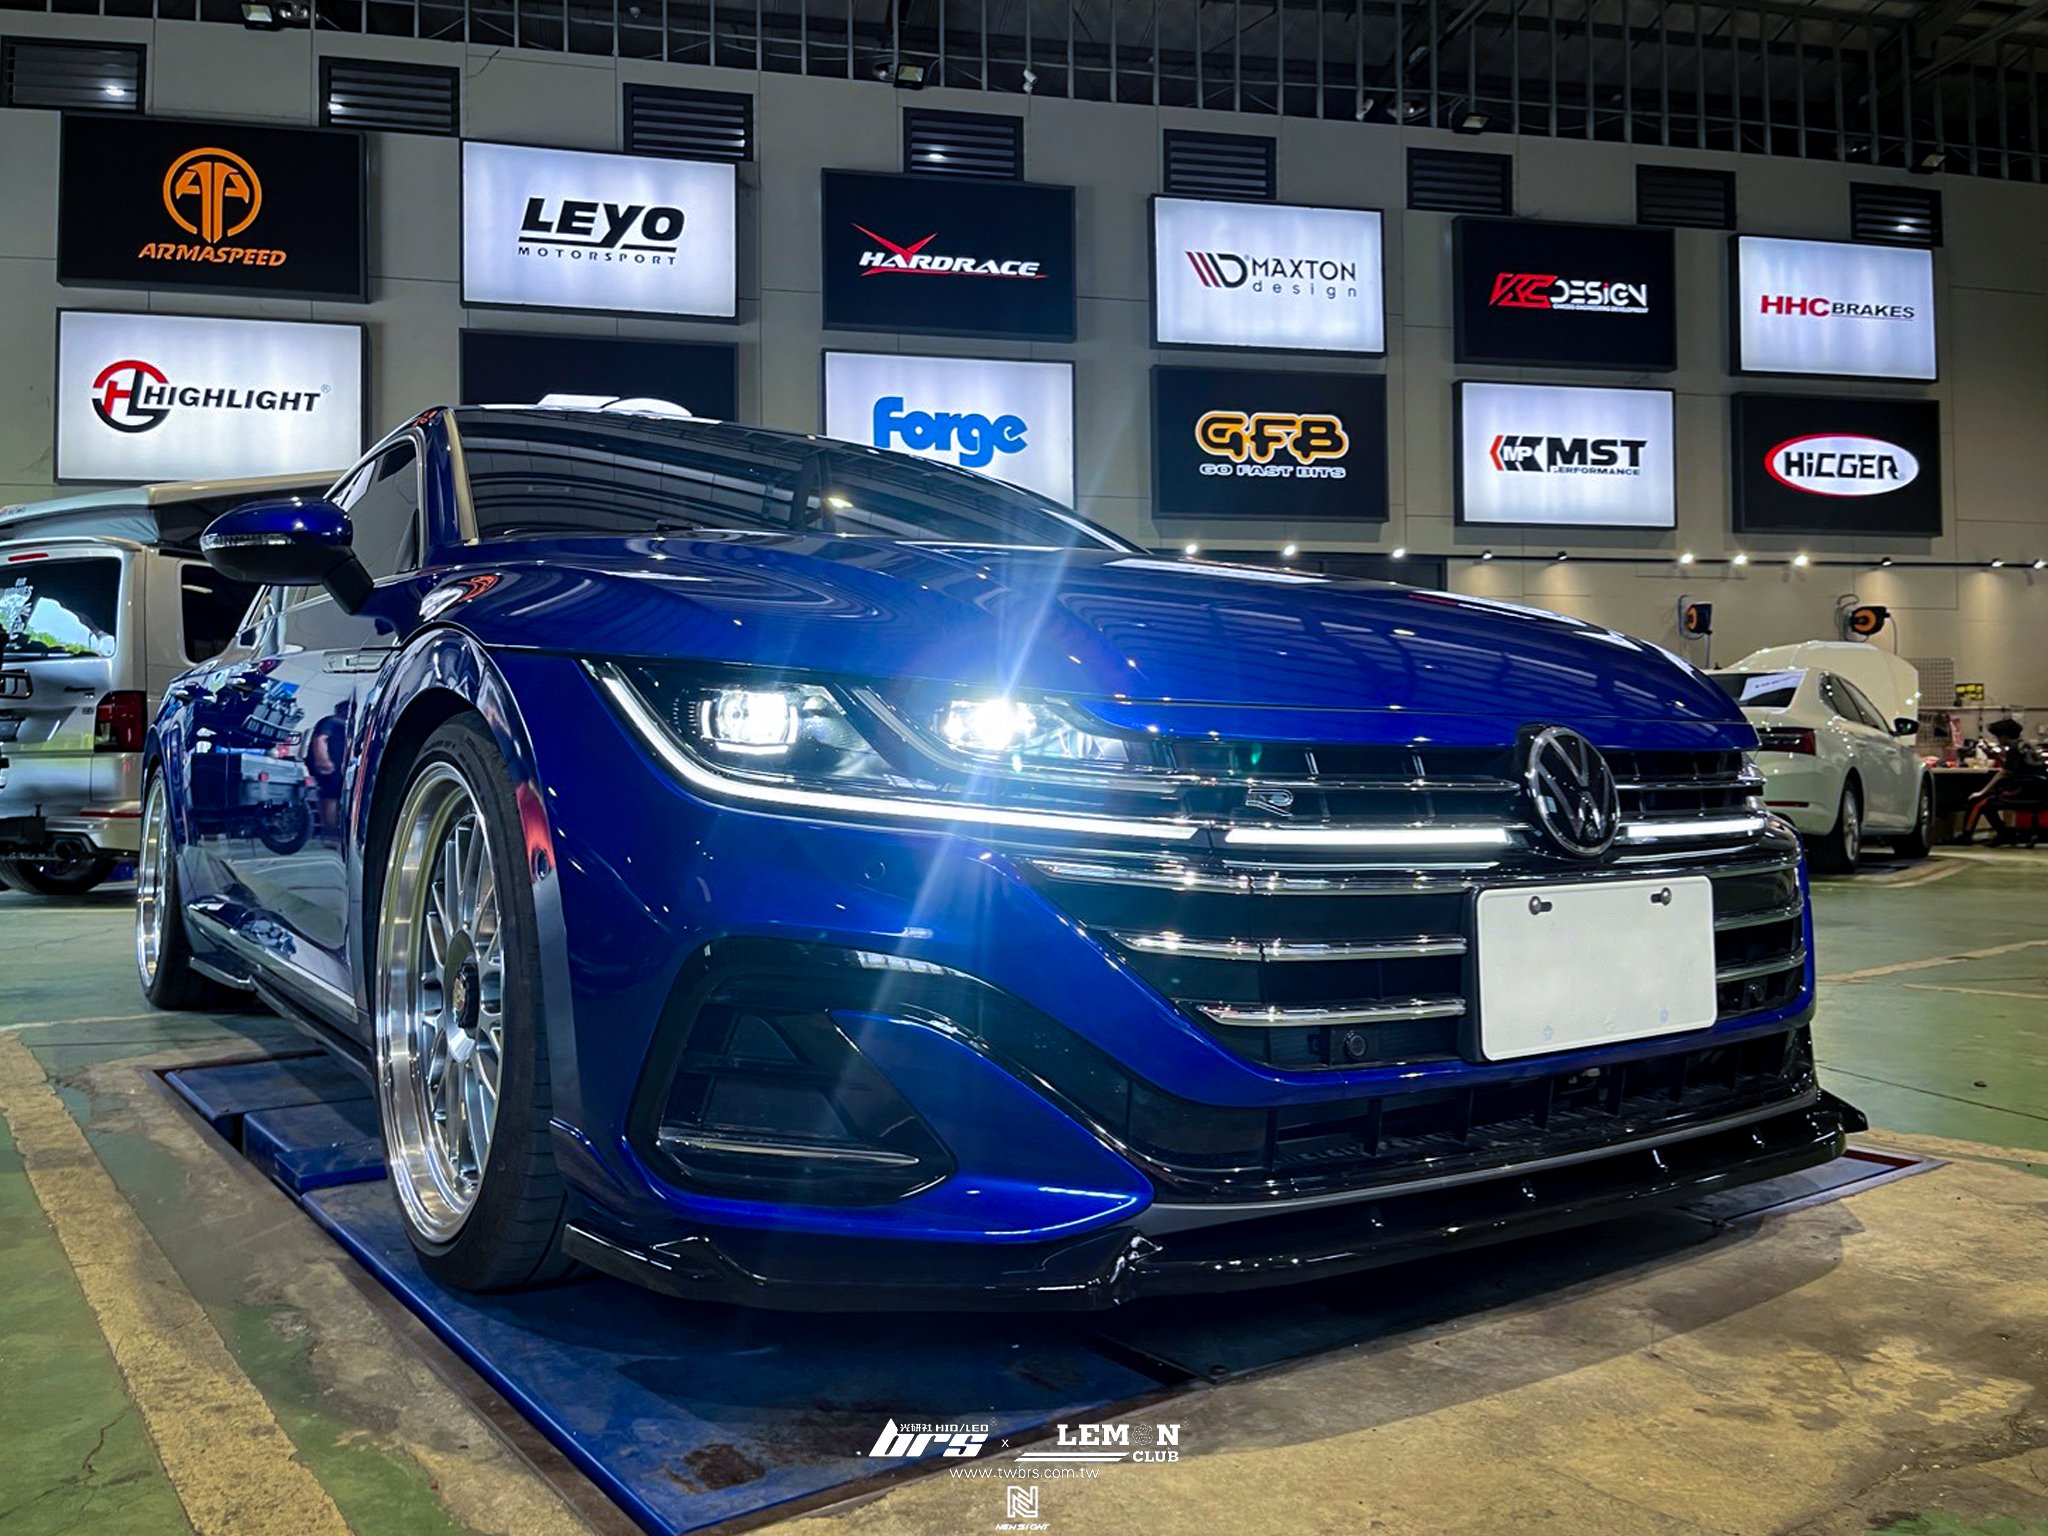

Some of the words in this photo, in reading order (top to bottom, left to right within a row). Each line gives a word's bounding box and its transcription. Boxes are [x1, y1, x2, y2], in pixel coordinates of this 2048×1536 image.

[521, 197, 685, 249] LEYO
[138, 242, 287, 267] ARMASPEED
[518, 246, 676, 266] MOTORSPORT
[858, 251, 1041, 277] HARDRACE
[1252, 257, 1356, 281] MAXTON
[1252, 280, 1357, 299] design
[1760, 295, 1830, 317] HHC
[1831, 302, 1915, 319] BRAKES
[143, 385, 321, 412] HIGHLIGHT
[1195, 410, 1349, 465] GFB
[1546, 437, 1648, 467] MST
[1199, 463, 1233, 475] GO
[1236, 465, 1293, 477] FAST
[1296, 467, 1346, 478] BITS
